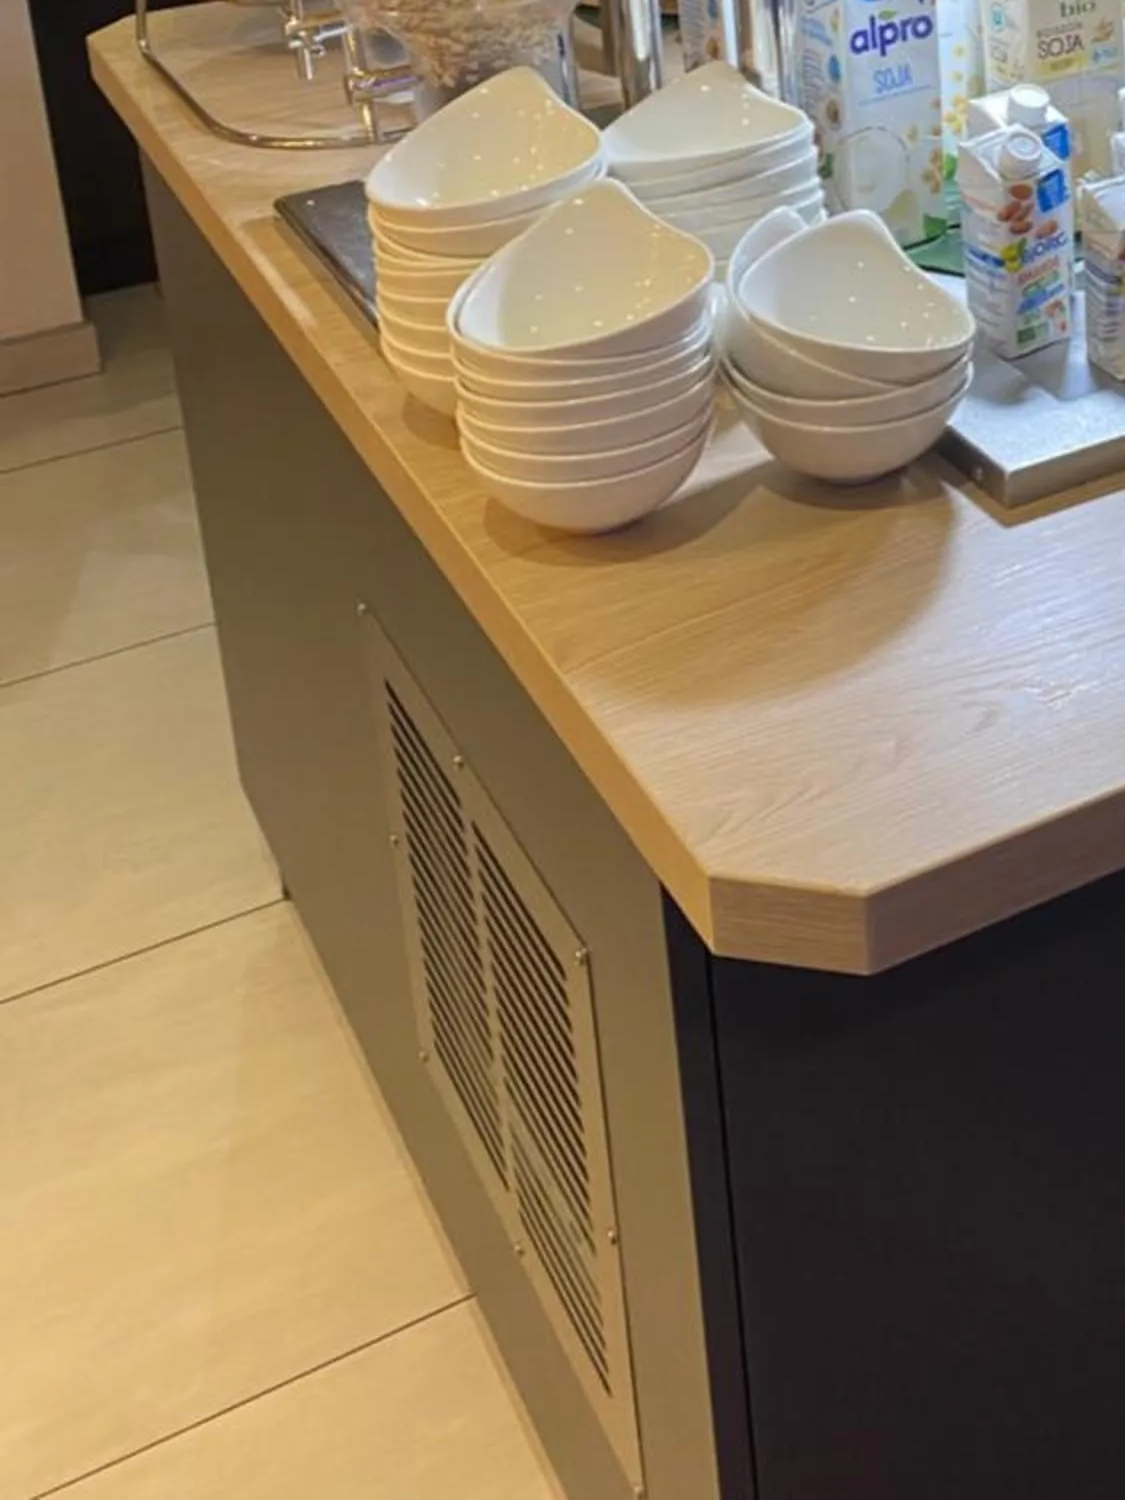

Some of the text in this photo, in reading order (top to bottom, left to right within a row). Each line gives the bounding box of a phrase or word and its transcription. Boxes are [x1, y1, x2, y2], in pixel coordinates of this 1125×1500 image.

[1060, 0, 1096, 18] bio
[851, 15, 933, 57] alpro
[1037, 33, 1085, 60] SOJA
[873, 63, 913, 94] SOJA
